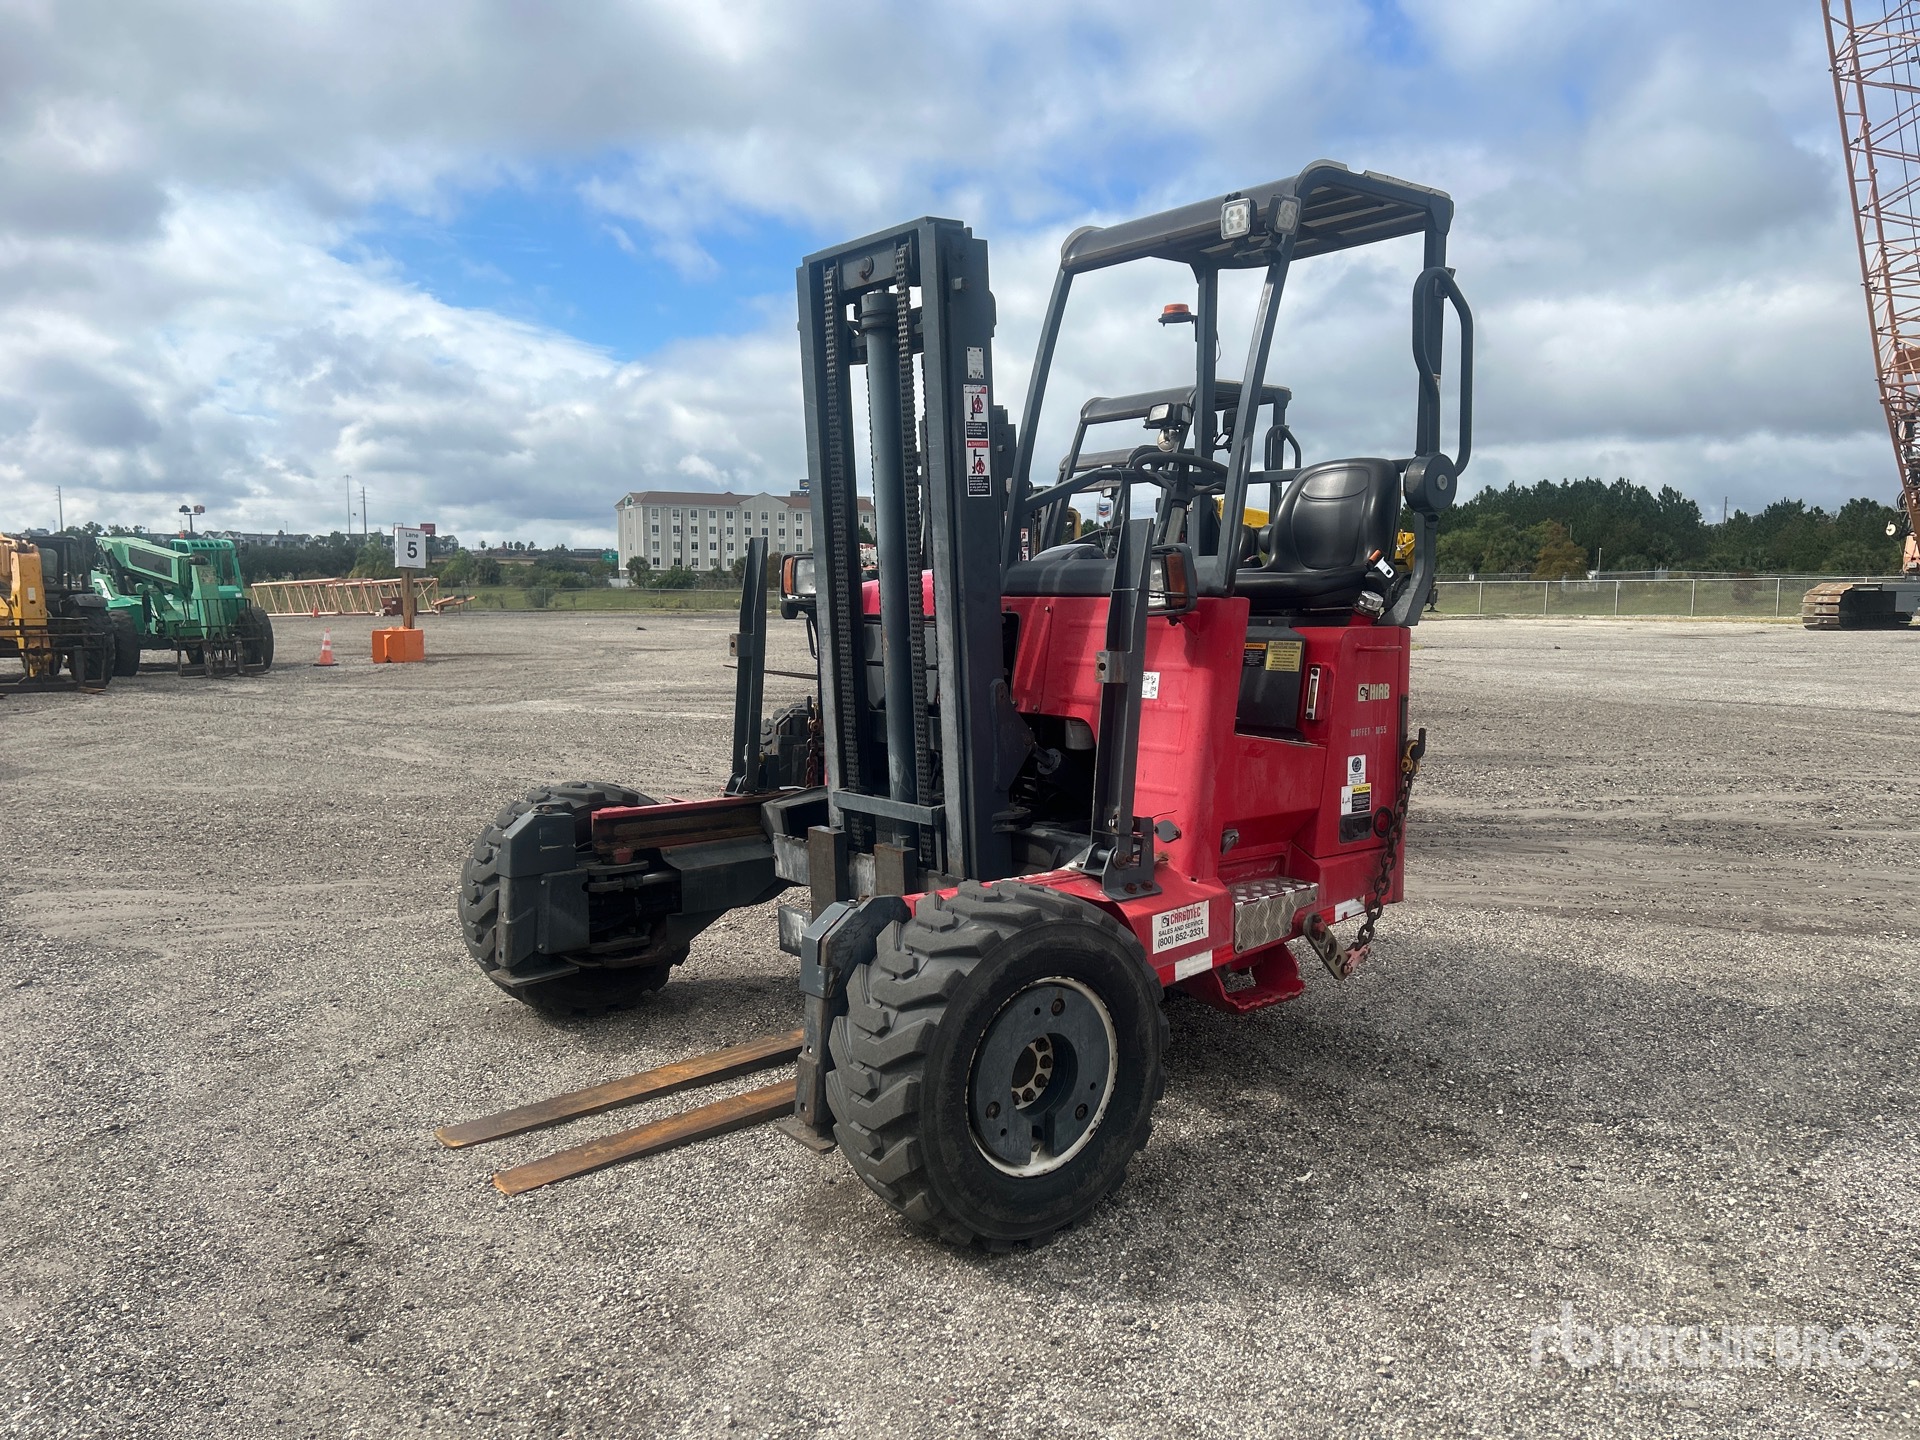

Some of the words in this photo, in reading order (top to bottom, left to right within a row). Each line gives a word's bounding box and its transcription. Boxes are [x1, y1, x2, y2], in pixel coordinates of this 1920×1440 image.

[407, 541, 418, 559] 5
[1369, 683, 1390, 700] HIAB
[1170, 907, 1201, 924] CARGOTEC
[1158, 927, 1173, 937] SALES
[1174, 924, 1184, 933] AND
[1185, 918, 1204, 929] SERVICE
[1157, 935, 1174, 949] (800)
[1175, 926, 1204, 942] 852-2331
